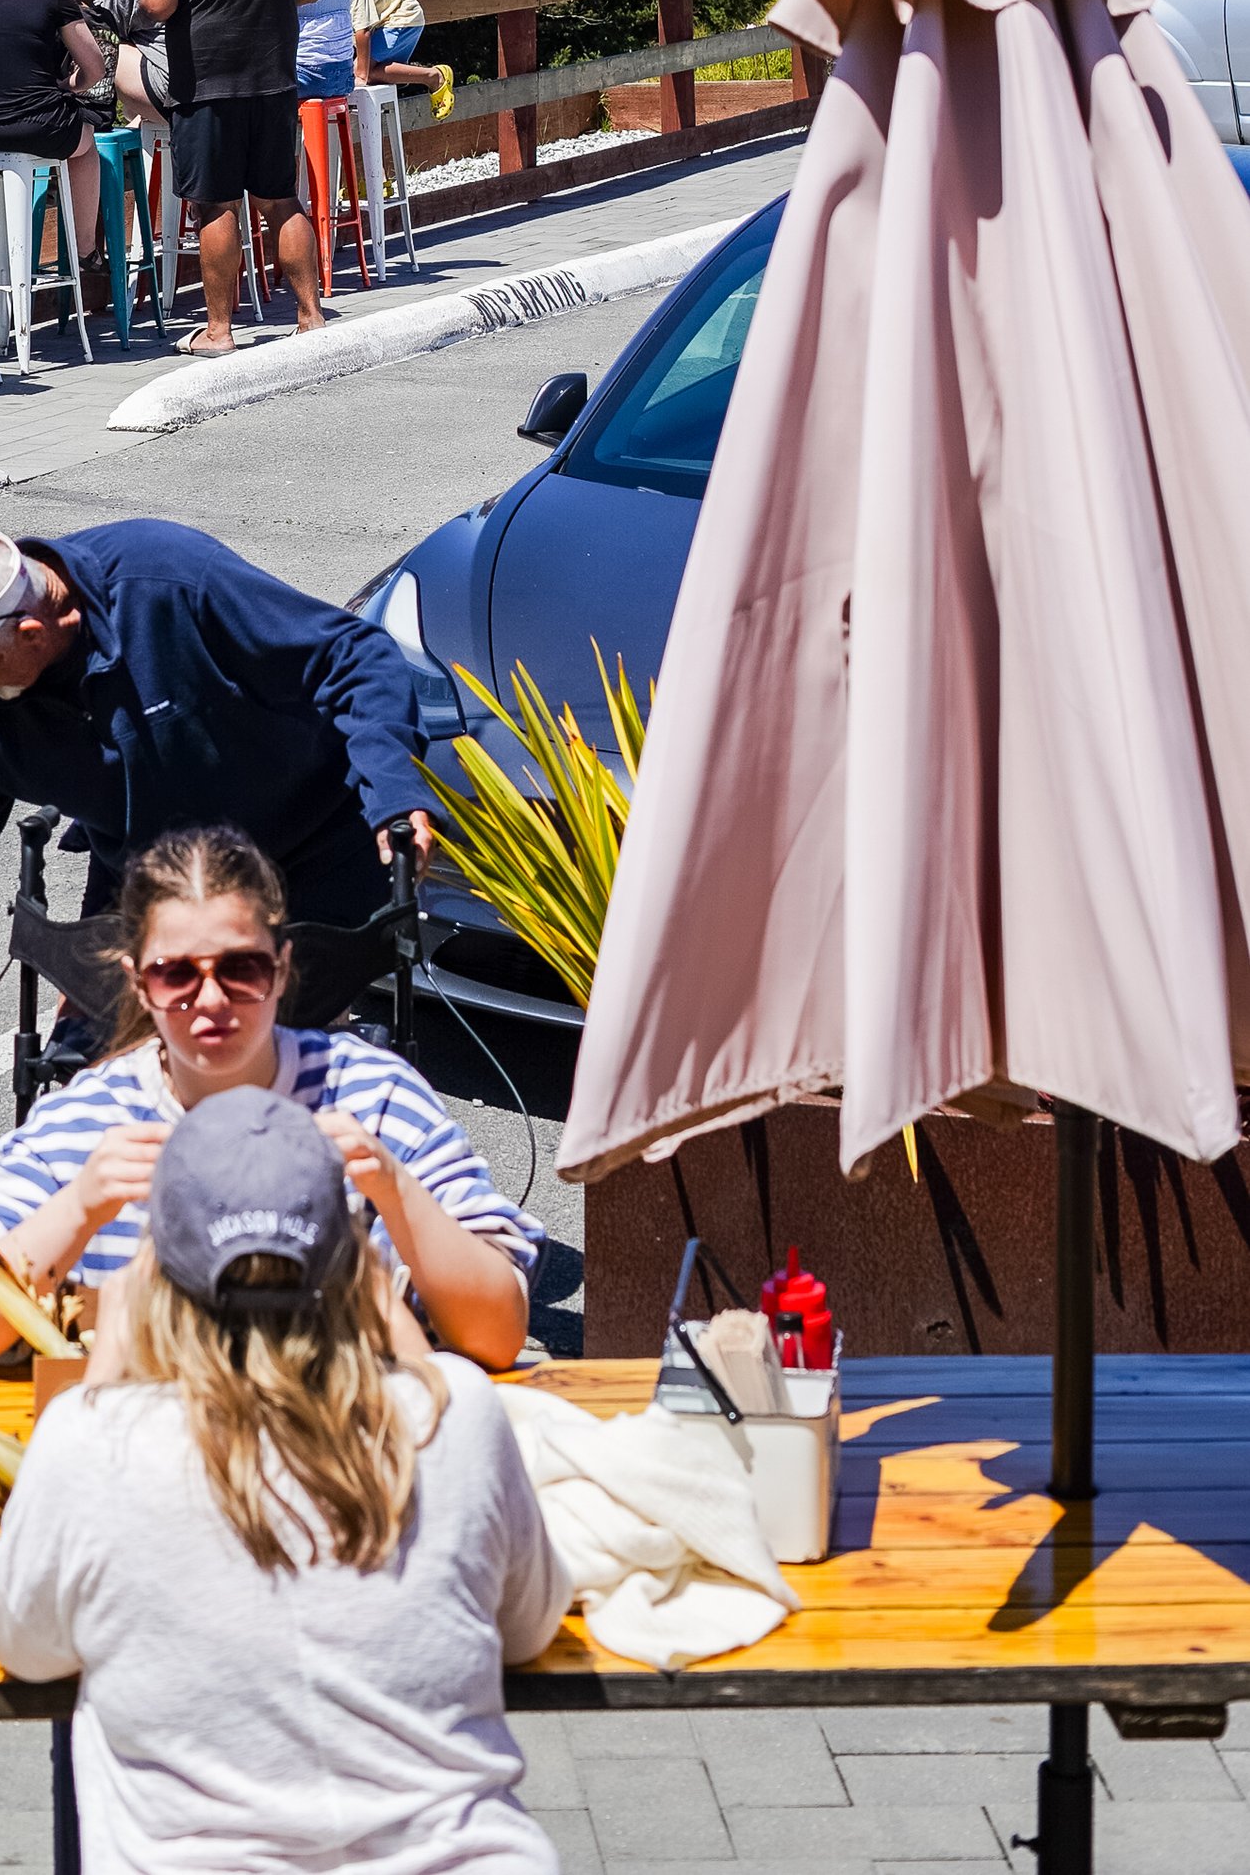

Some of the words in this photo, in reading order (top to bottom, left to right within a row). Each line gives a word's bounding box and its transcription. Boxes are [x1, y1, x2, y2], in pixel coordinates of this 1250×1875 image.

[460, 293, 507, 328] NO
[481, 269, 586, 322] PARKING
[207, 1209, 278, 1247] JACKSON
[280, 1212, 320, 1245] HOLE
